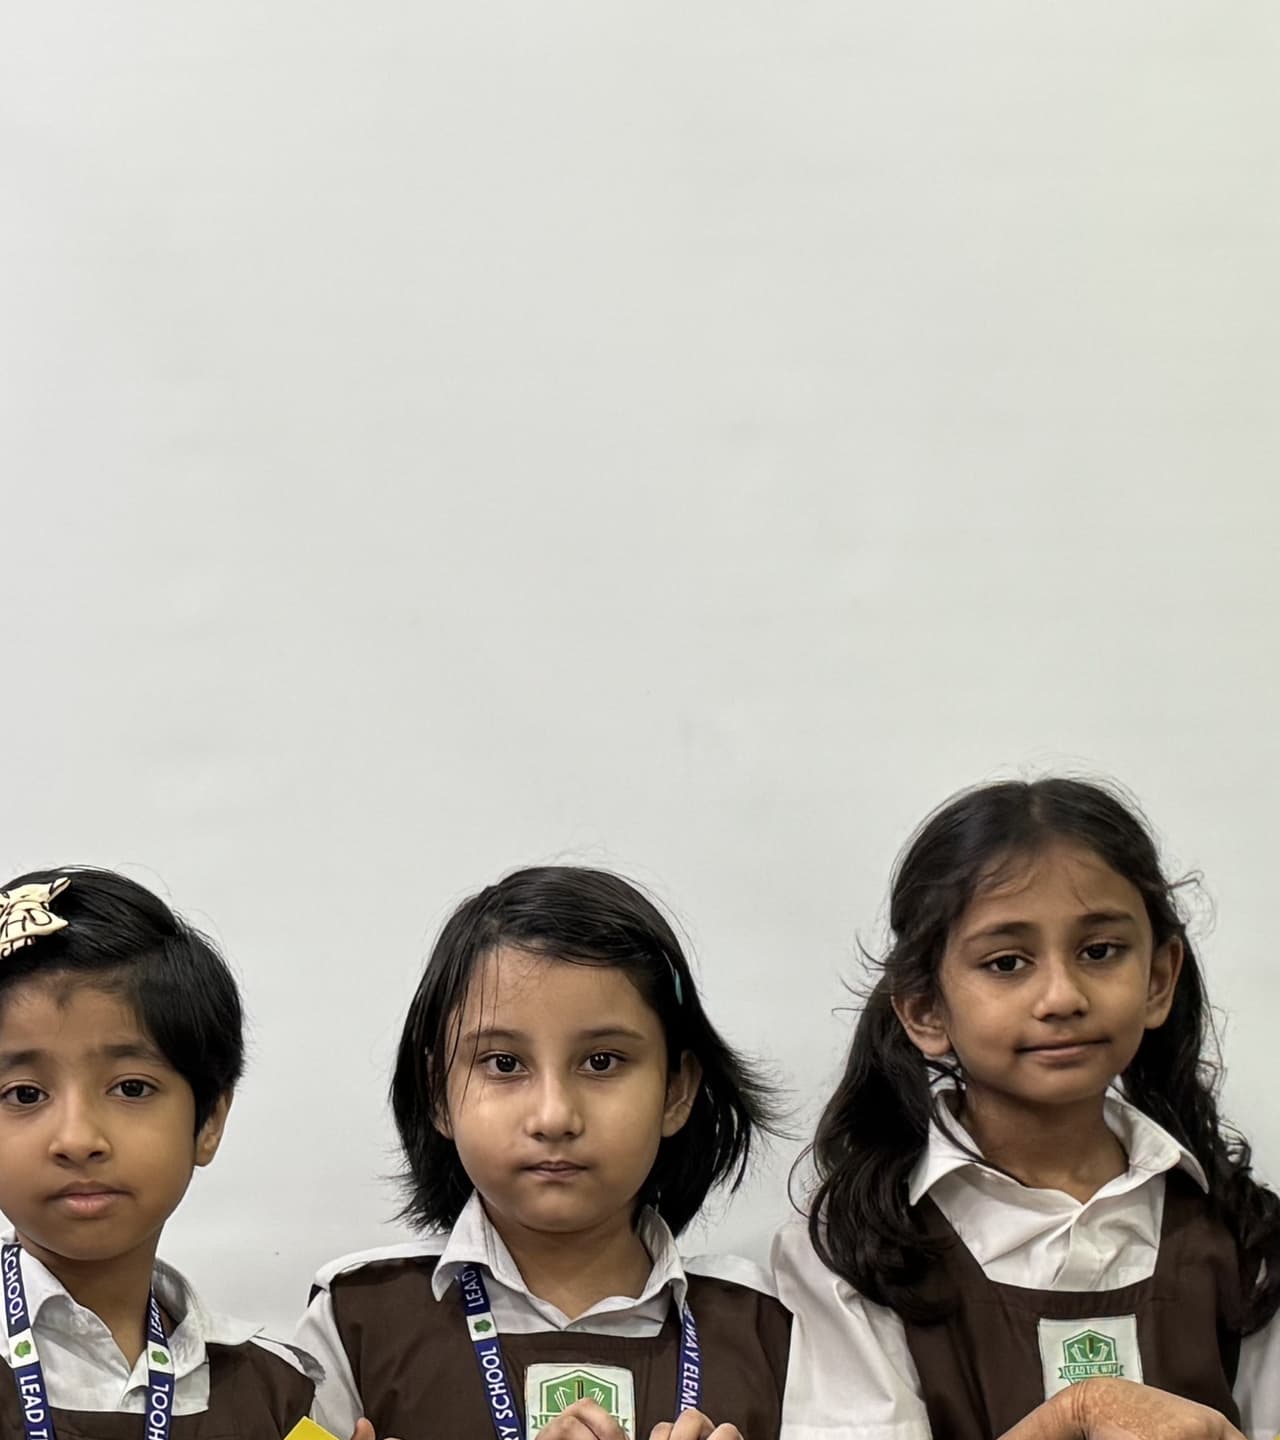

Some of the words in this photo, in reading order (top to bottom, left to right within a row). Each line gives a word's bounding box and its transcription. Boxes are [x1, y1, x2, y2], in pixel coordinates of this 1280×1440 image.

[461, 1270, 486, 1308] LEAD
[4, 1247, 25, 1325] SCHOOL
[20, 1375, 45, 1424] LEAD
[480, 1346, 513, 1420] SCHOOL
